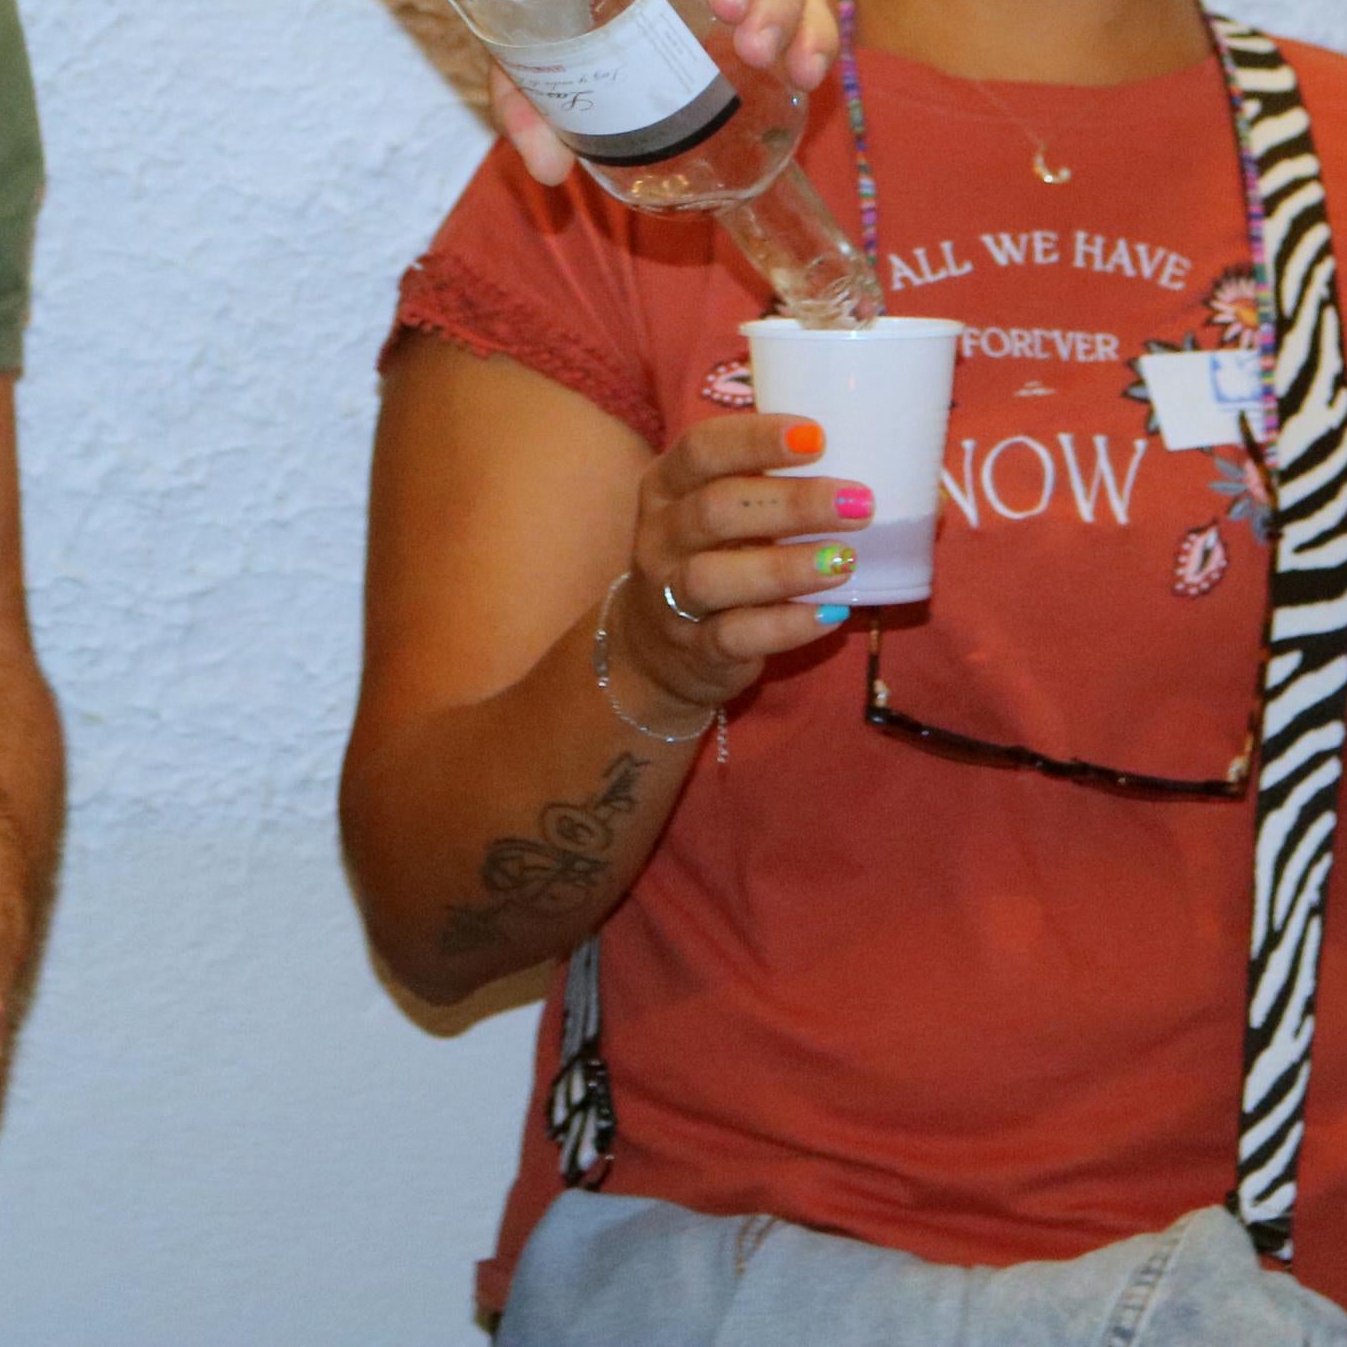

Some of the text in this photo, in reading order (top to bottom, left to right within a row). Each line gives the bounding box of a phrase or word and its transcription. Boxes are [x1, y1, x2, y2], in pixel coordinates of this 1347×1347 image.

[887, 229, 1192, 291] ALL WE HAVE
[960, 326, 1120, 363] FOREVER
[940, 432, 1148, 529] NOW
